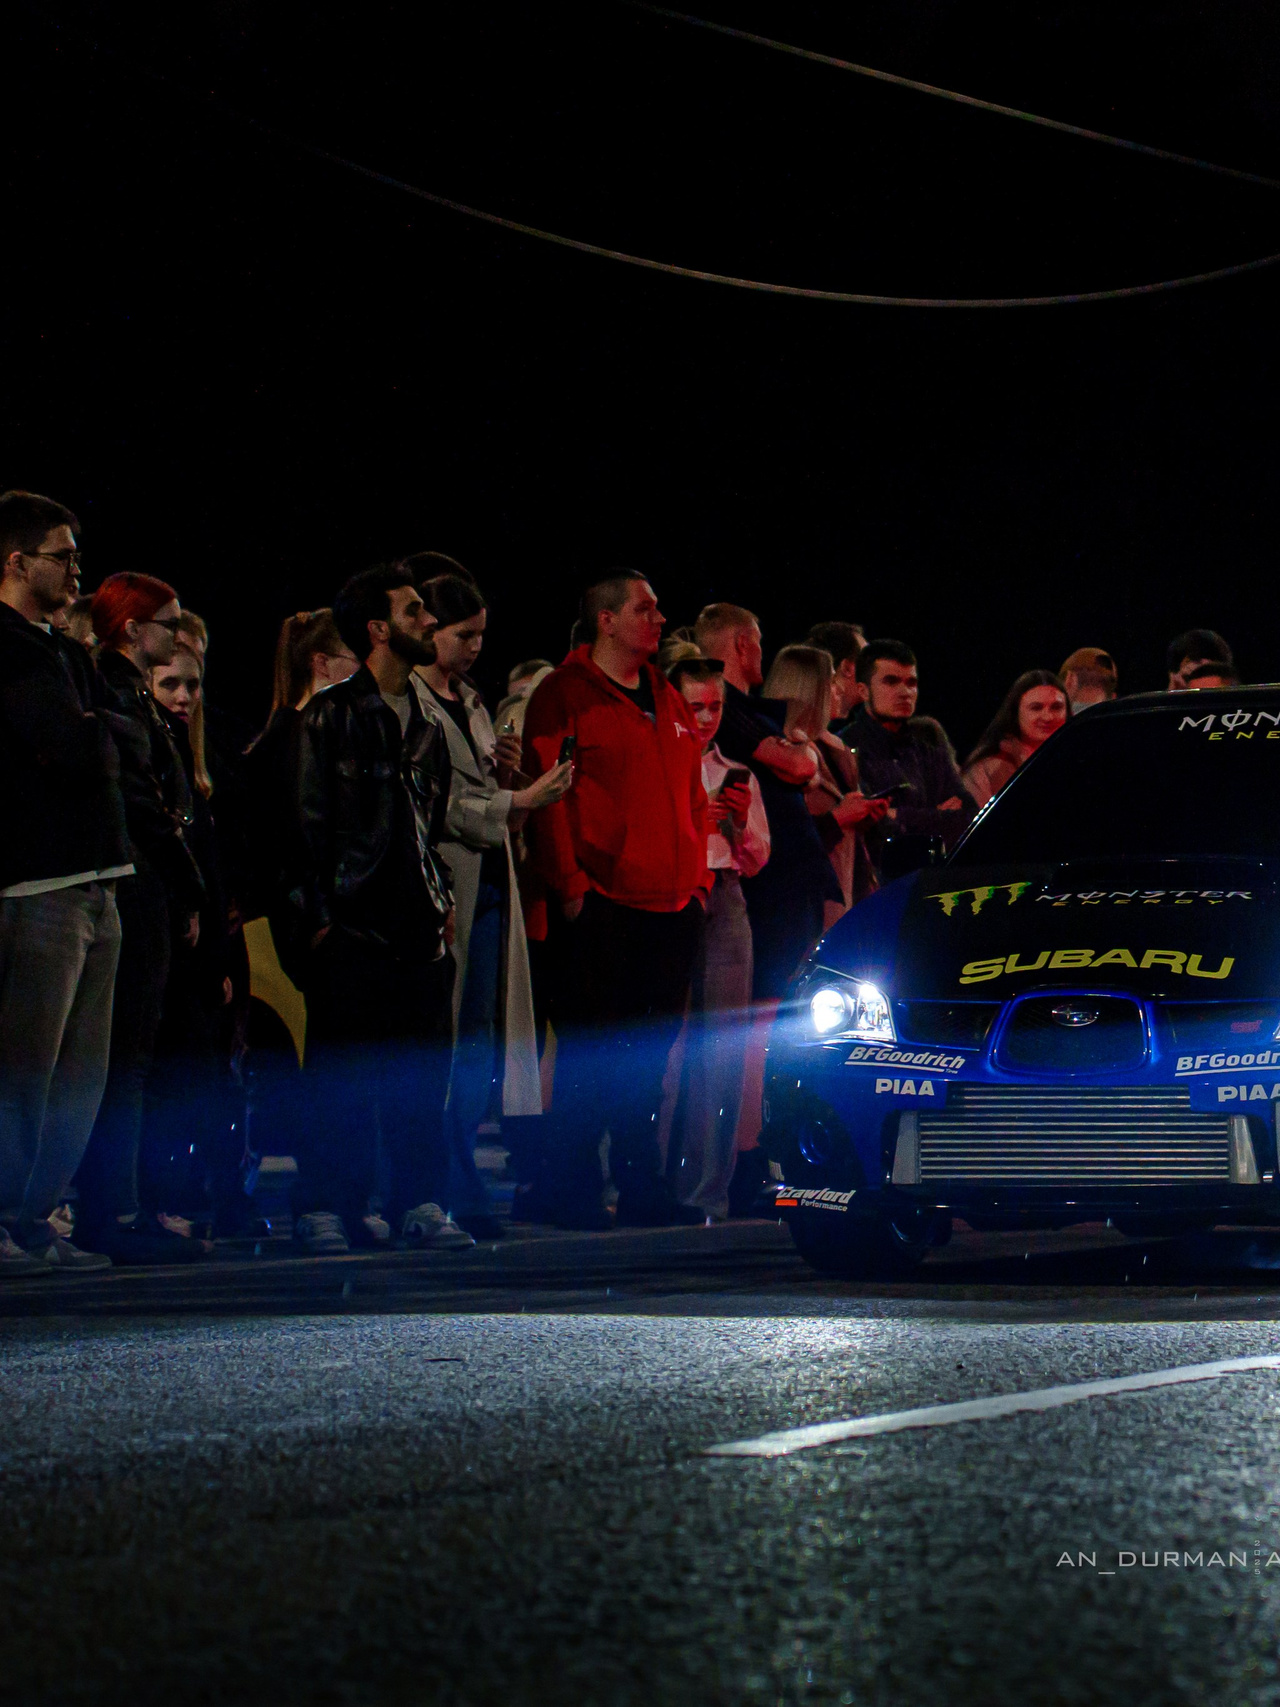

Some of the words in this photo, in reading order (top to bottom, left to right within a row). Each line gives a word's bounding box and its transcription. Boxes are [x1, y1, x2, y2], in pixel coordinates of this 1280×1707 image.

[959, 949, 1235, 984] SUBARU
[847, 1046, 966, 1069] BFGoodrich
[875, 1078, 935, 1096] PIAA
[776, 1186, 857, 1204] Crawford
[800, 1199, 848, 1212] Performance
